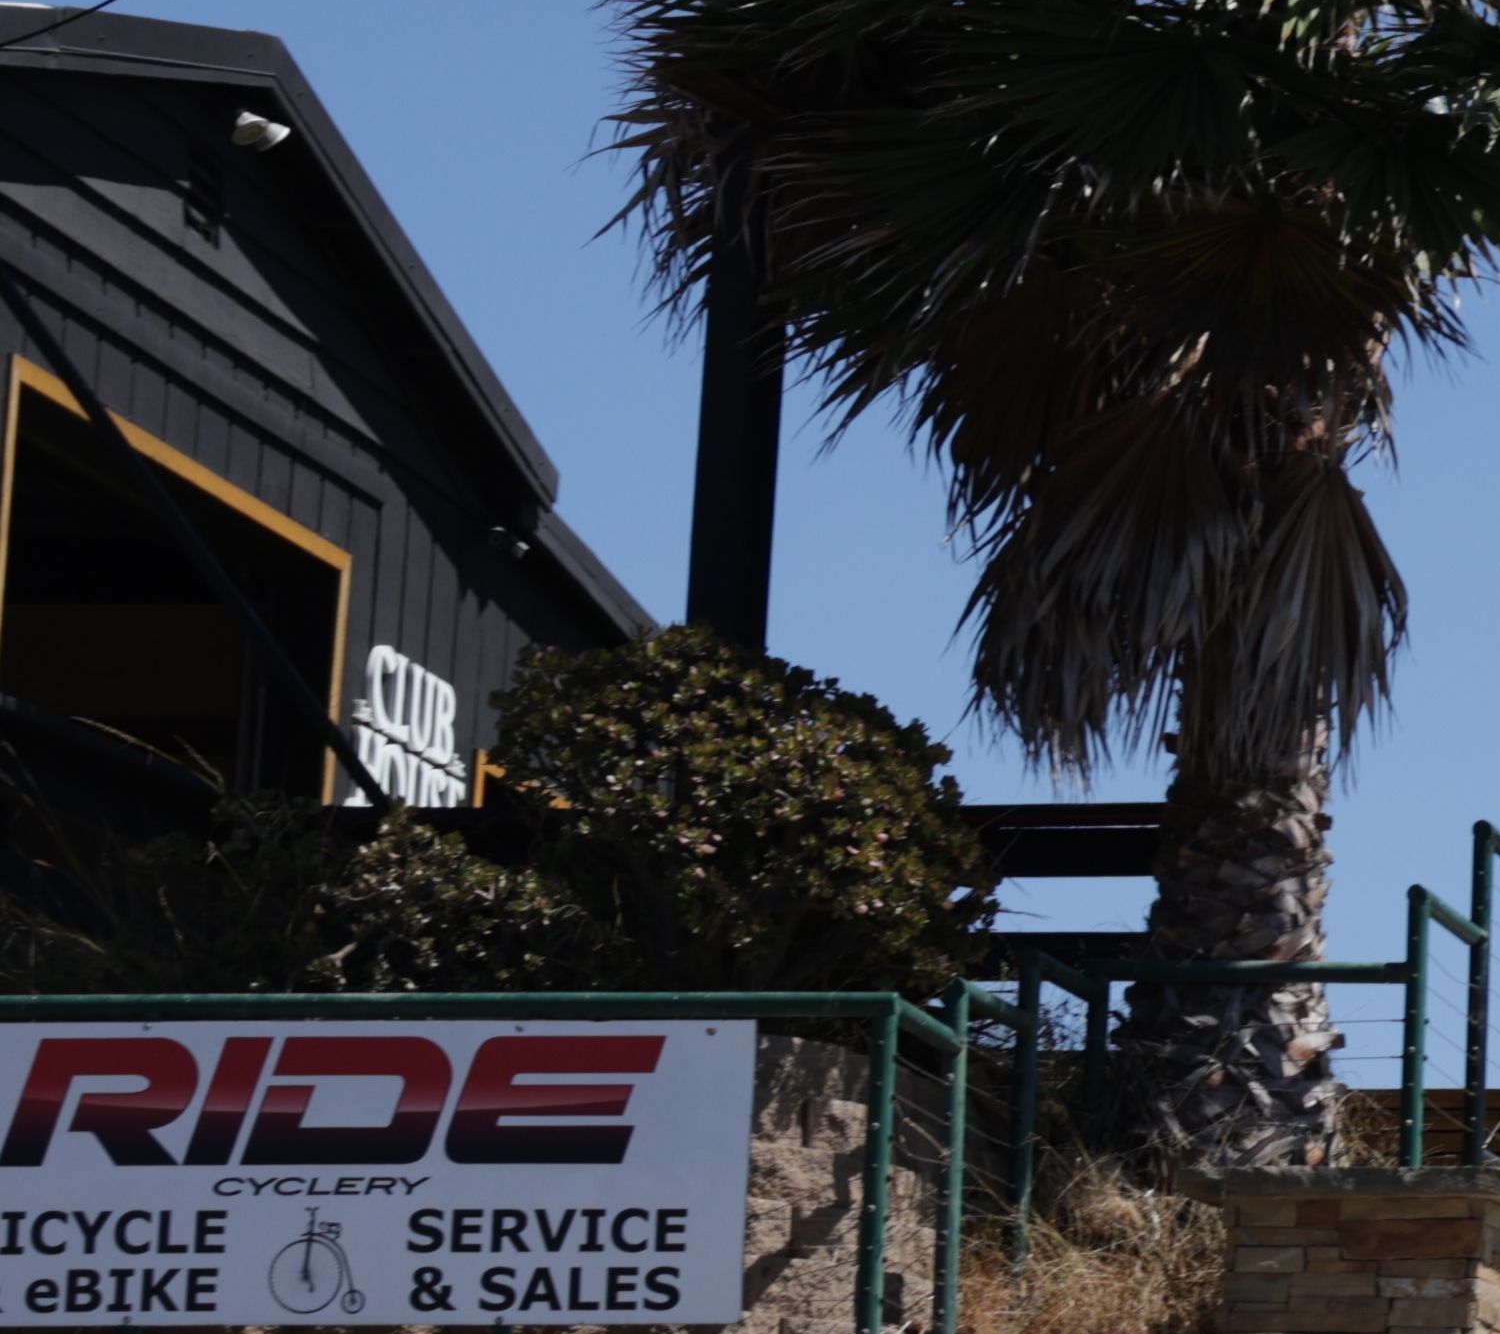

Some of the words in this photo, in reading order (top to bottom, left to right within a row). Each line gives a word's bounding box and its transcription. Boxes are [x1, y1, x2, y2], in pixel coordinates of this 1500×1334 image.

[366, 644, 457, 765] CLUB
[0, 1035, 667, 1167] RIDE
[212, 1176, 432, 1197] CYCLERY
[406, 1207, 688, 1254] SERVICE
[24, 1267, 220, 1313] eBIKE
[408, 1265, 457, 1312] &
[477, 1265, 681, 1312] SALES
